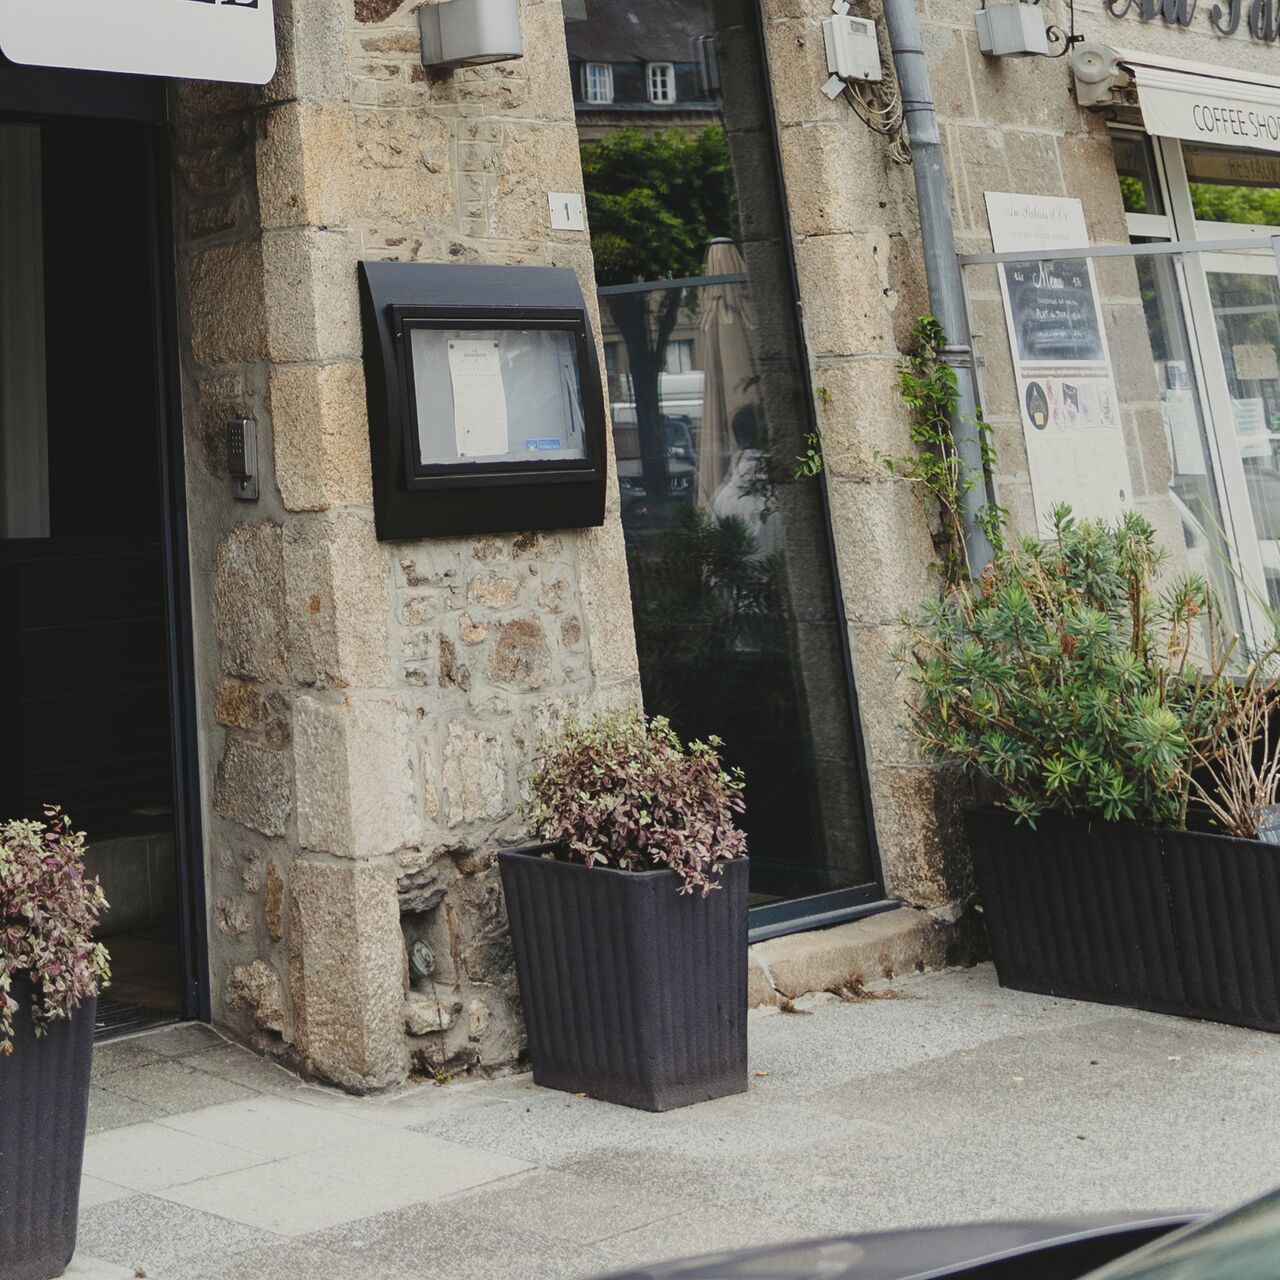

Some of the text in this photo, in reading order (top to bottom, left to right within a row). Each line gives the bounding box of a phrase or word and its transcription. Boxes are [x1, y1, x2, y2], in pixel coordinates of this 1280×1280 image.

[1193, 104, 1280, 140] COFFEE SHO
[563, 202, 571, 222] 1
